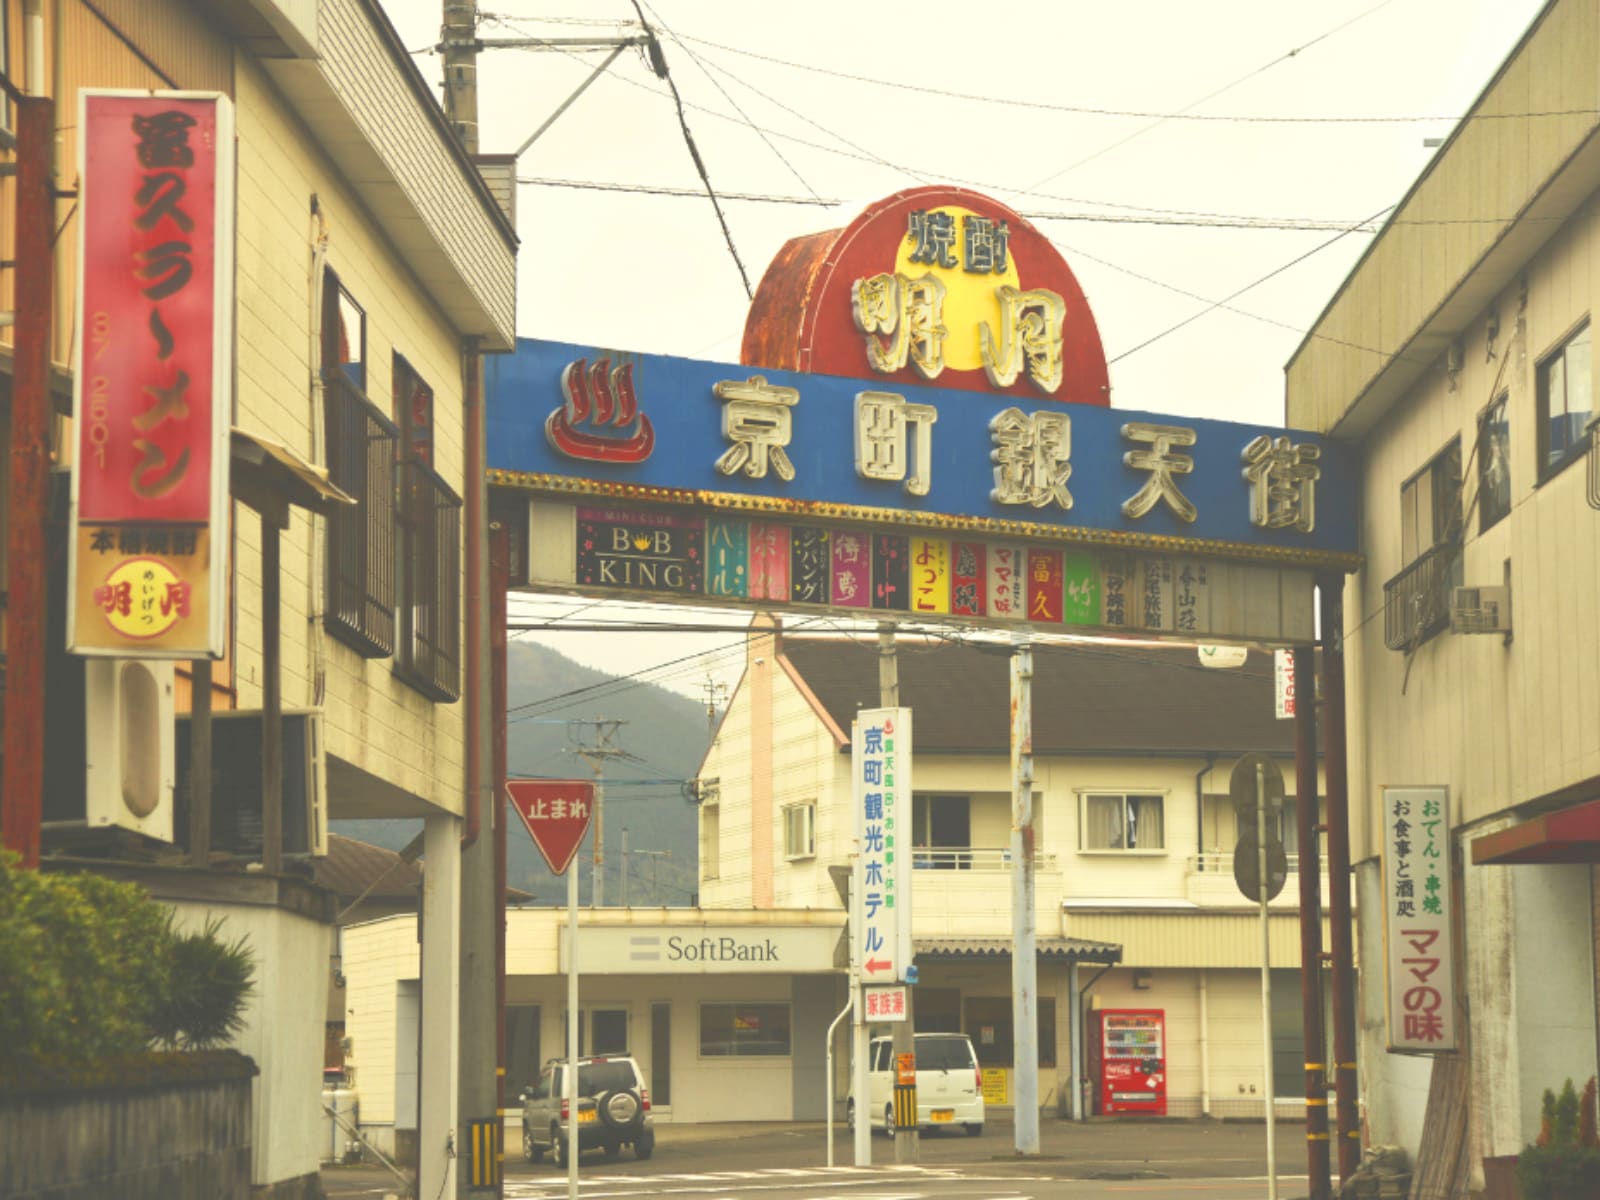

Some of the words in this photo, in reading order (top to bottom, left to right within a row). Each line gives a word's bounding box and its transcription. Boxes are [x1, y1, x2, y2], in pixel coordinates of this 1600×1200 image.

[851, 271, 1067, 394] 明月
[711, 375, 1323, 533] 京町銀天街
[140, 570, 155, 625] めいげつ
[599, 559, 684, 587] KING
[994, 549, 1013, 616] ママの味
[527, 797, 589, 820] 止まれ
[863, 726, 884, 953] 京町観光ホテル
[667, 936, 780, 962] SoftBank
[1400, 929, 1445, 1043] ママの味
